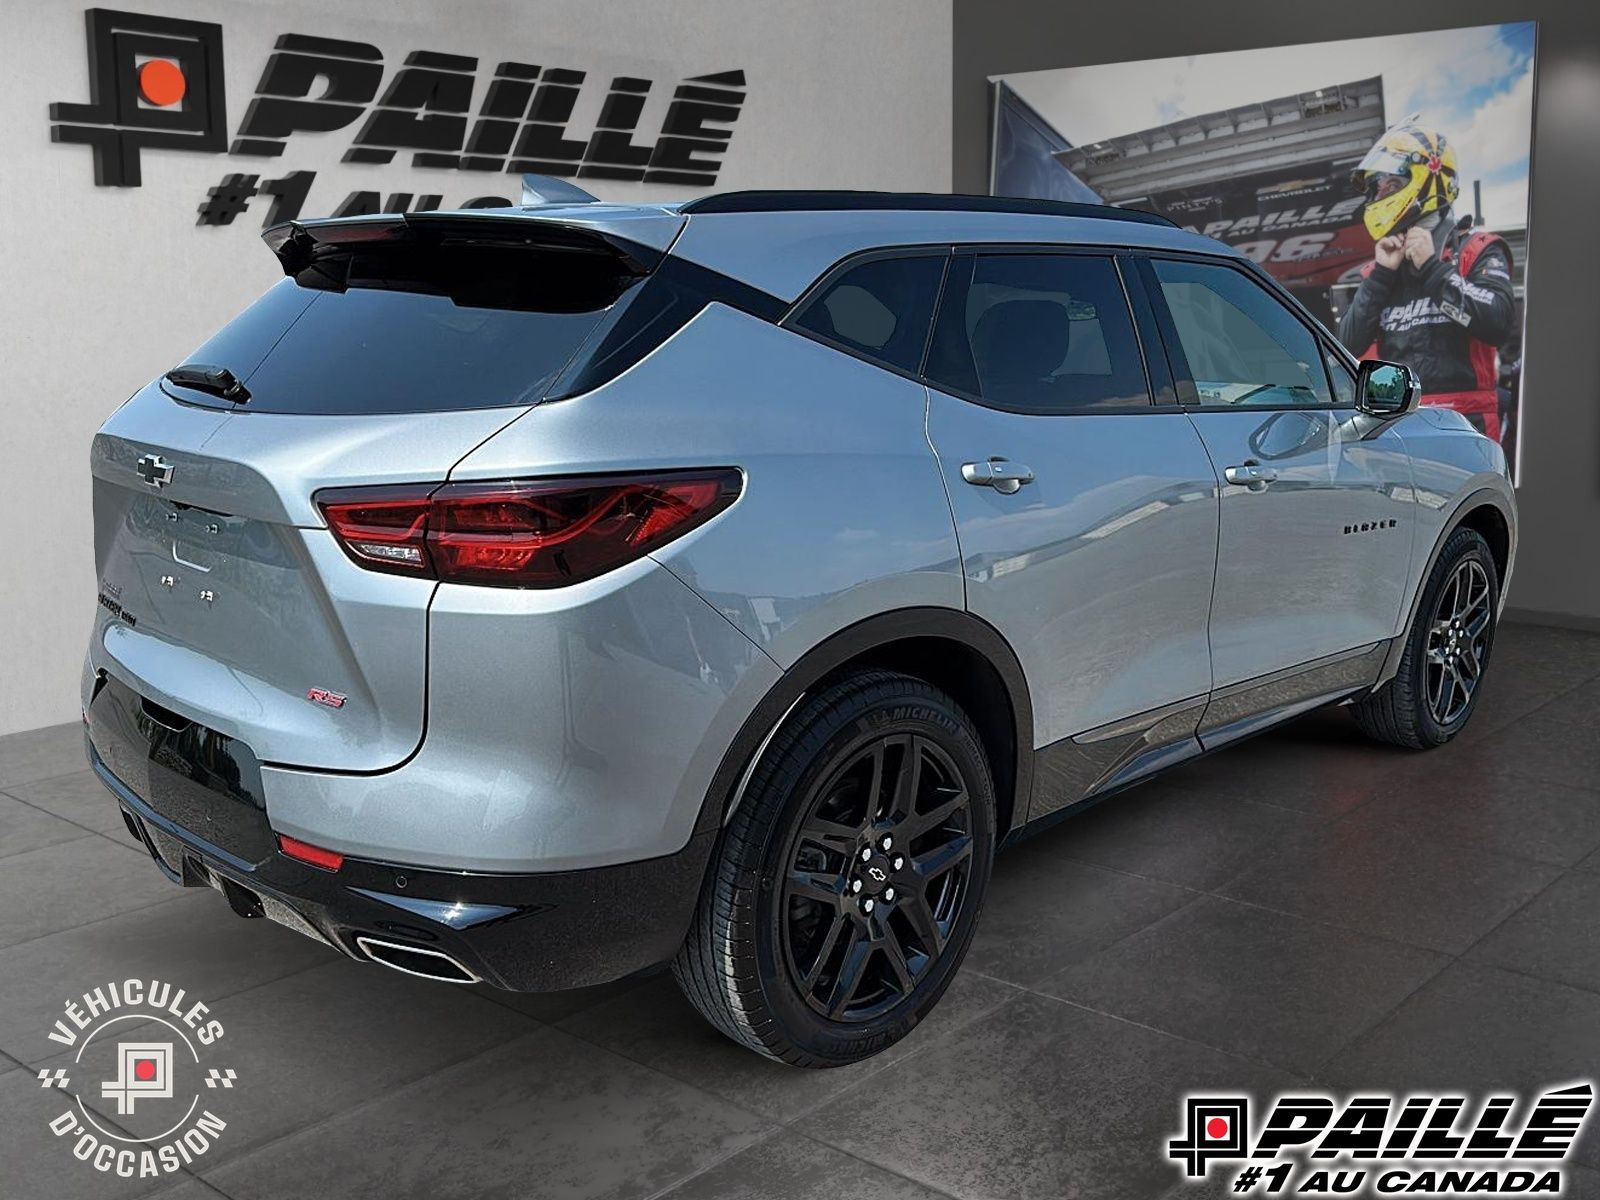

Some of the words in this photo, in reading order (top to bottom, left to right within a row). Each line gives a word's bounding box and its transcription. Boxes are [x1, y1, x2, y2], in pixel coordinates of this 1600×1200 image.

[228, 33, 746, 186] PAILLÉ
[1257, 185, 1332, 201] CHEVROLET
[307, 687, 346, 709] RS
